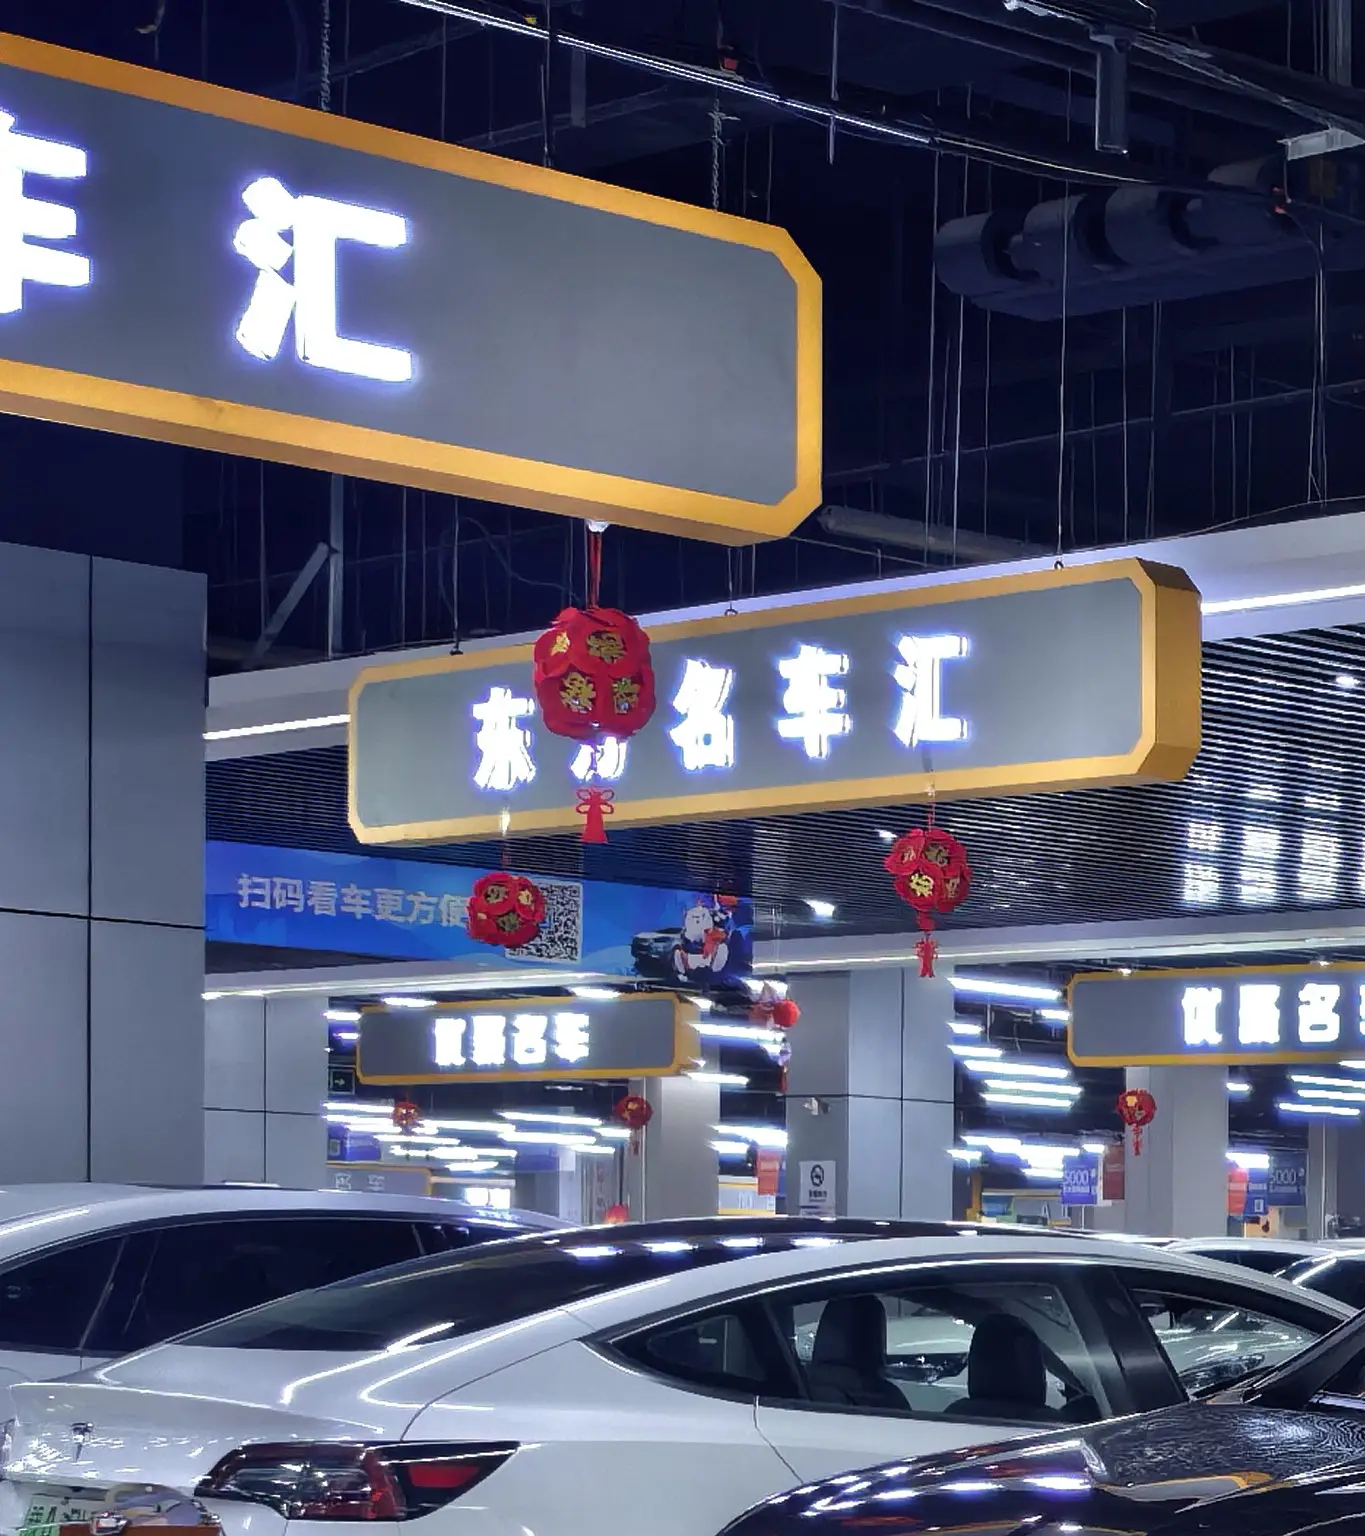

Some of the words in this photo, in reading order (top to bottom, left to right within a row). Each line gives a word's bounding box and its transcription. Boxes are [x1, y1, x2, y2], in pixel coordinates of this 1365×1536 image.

[470, 631, 974, 792] 东名车汇
[237, 873, 470, 928] 扫码看车更方便
